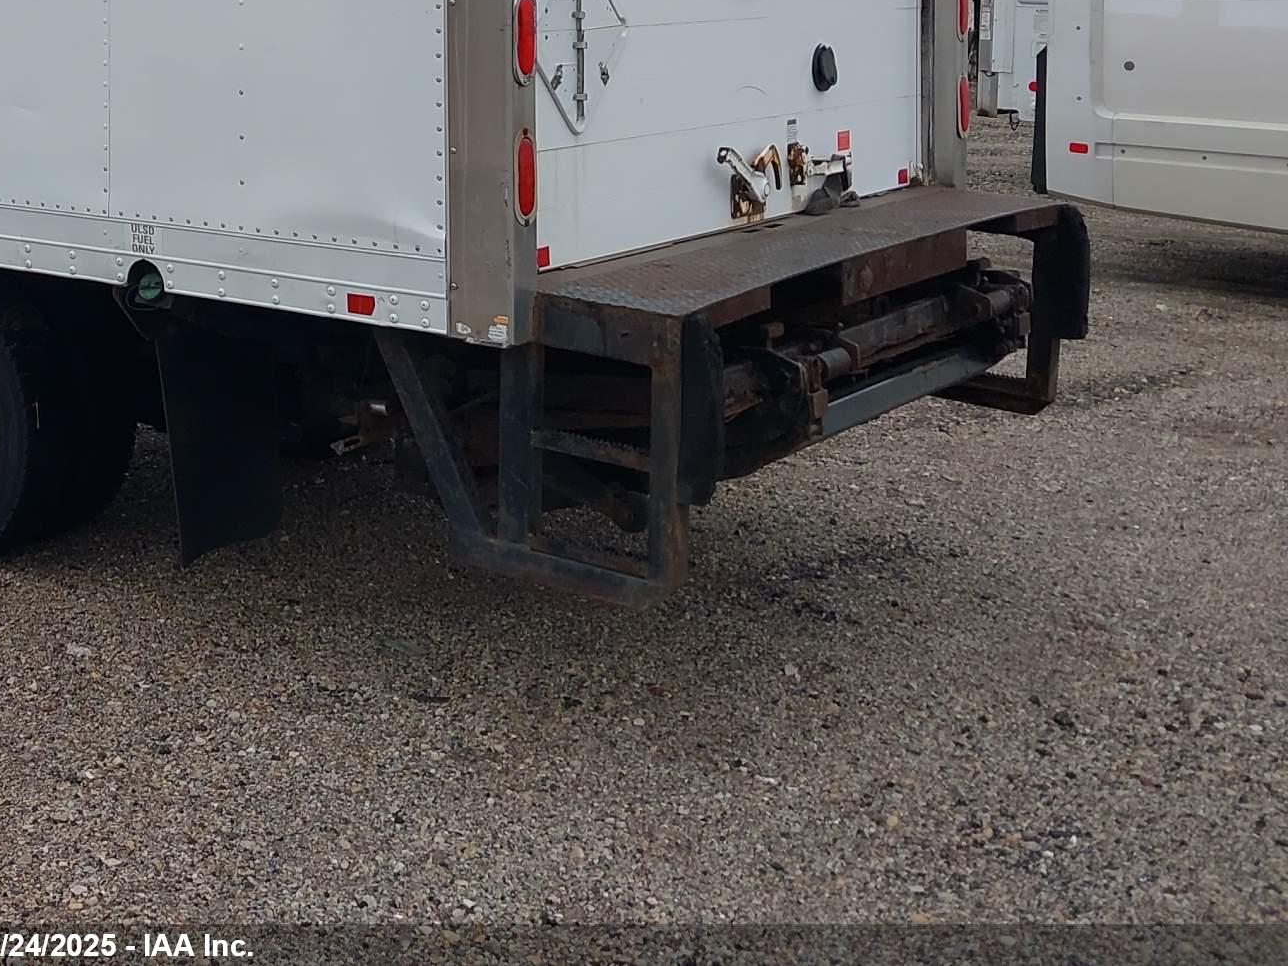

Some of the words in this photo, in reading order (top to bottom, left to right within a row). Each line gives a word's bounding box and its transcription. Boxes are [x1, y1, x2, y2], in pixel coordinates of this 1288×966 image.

[131, 224, 155, 235] ULSD
[132, 234, 155, 245] FUEL
[132, 244, 155, 255] ONLY
